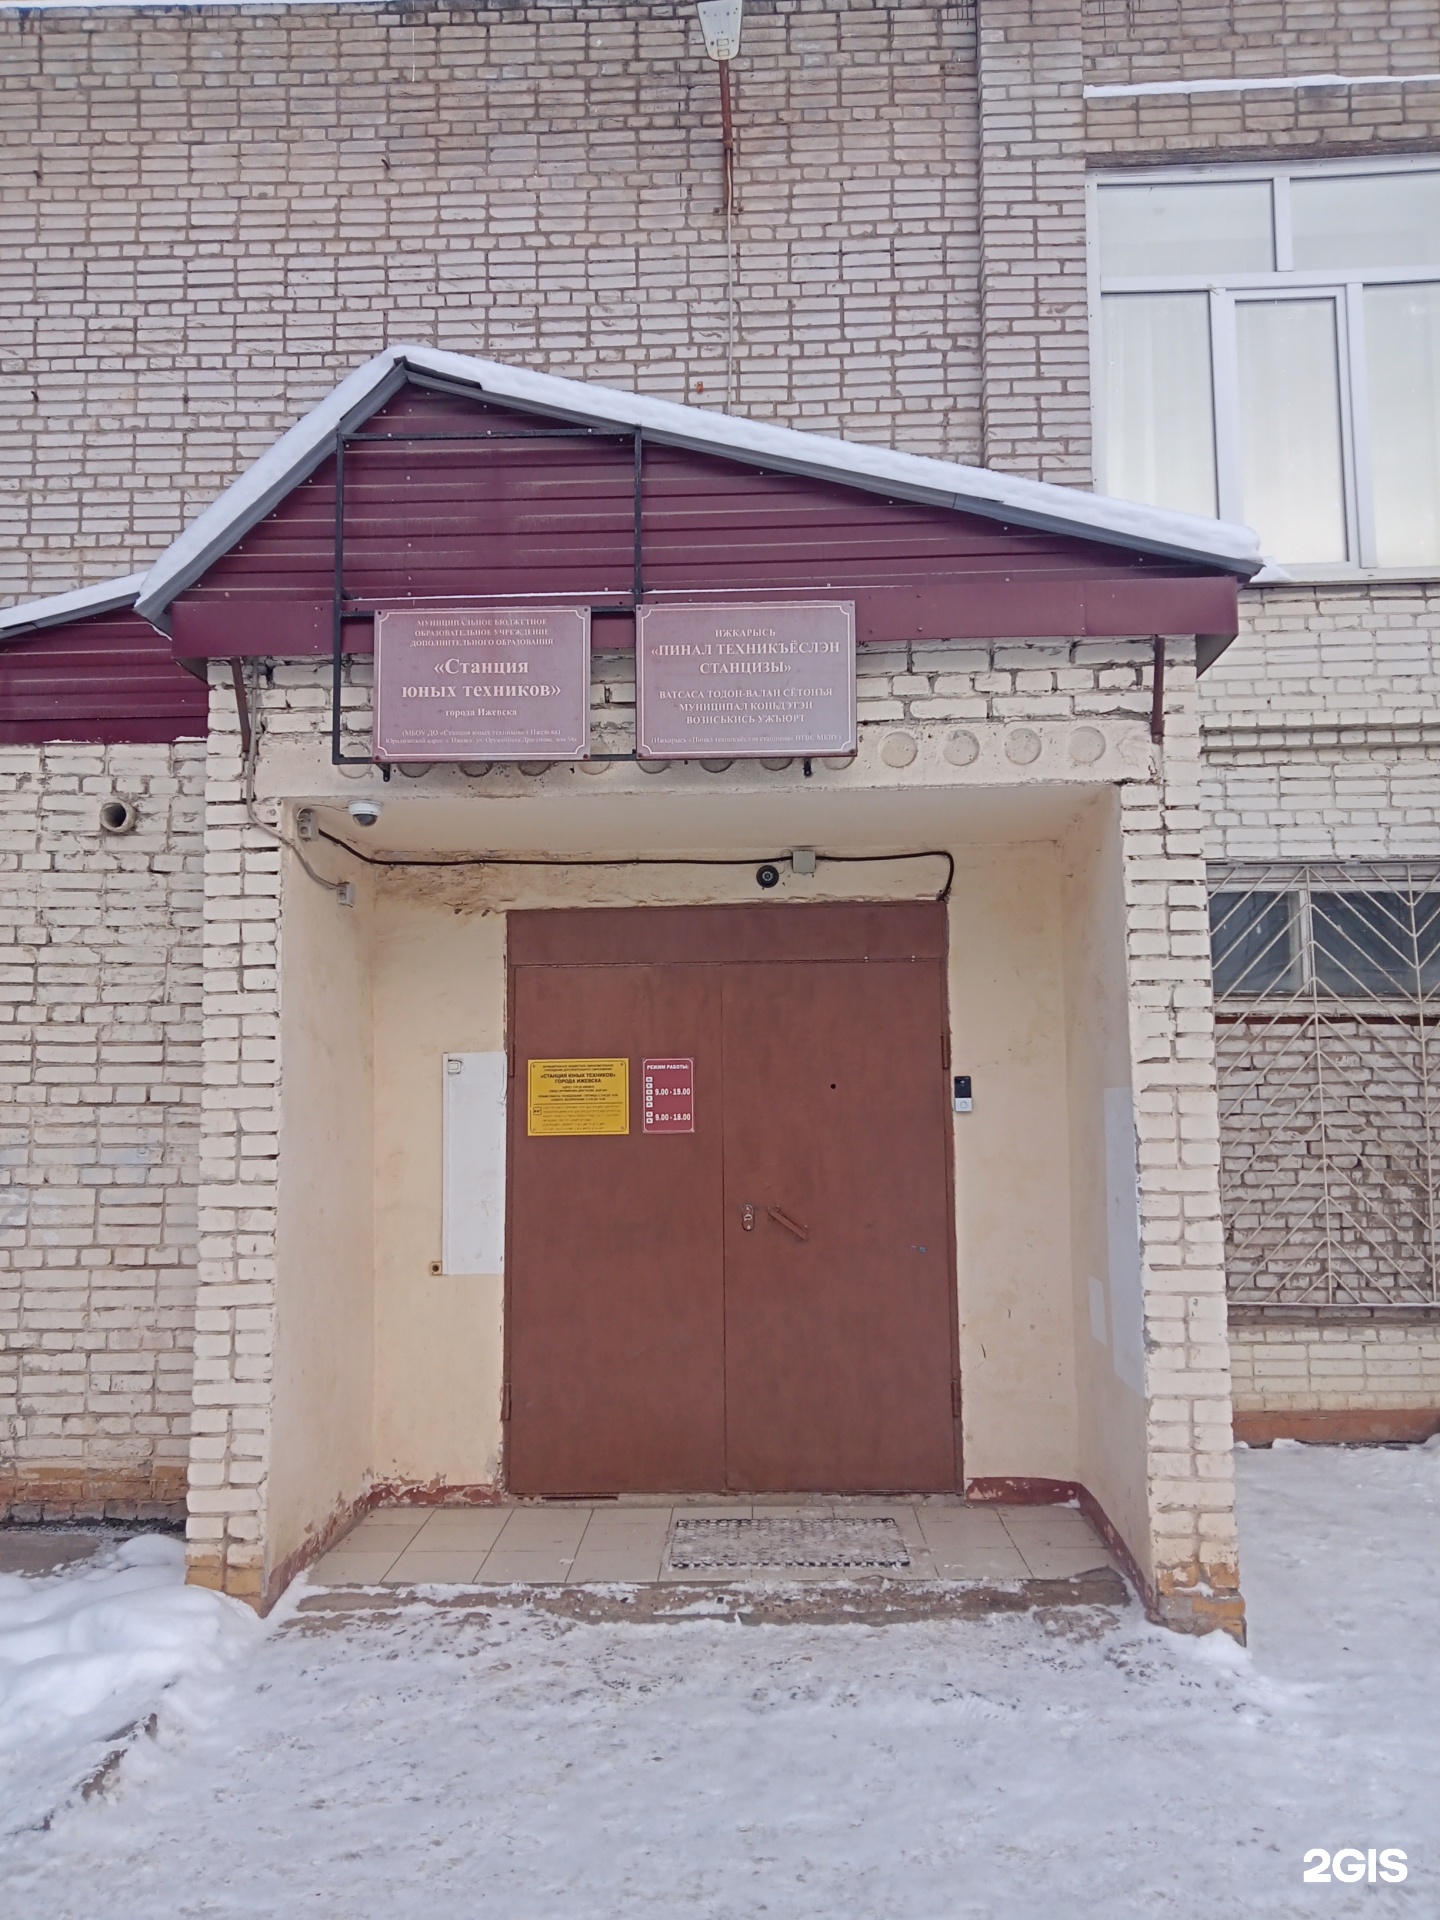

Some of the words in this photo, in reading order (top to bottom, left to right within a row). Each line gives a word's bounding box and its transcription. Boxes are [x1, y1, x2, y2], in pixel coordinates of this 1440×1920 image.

[417, 619, 493, 627] МУНИЦИПАЛЬНОЕ
[494, 618, 548, 626] БЮДЖЕТНОЕ
[414, 629, 492, 637] ОБРАЗОВАТЕЛЬНОЕ
[493, 628, 550, 636] УЧРЕЖДЕНИЕ
[715, 628, 776, 638] ИЖКАРЫСЬ
[410, 638, 495, 647] ДОПОЛНИТЕЛЬНОГО
[495, 638, 554, 646] ОБРАЗОВАНИЯ
[651, 644, 713, 657] «ПИНАЛ
[716, 640, 840, 655] ТЕХНИКЪЁСЛЭН
[433, 658, 529, 675] «Станция
[700, 661, 792, 675] СТАНЦИЗЫ»
[402, 686, 457, 698] юных
[462, 684, 561, 698] техников»
[659, 690, 704, 699] ВАТСАСА
[707, 689, 780, 700] ТОДОН-ВАЛАН
[679, 702, 748, 712] МУНИЦИПАЛ
[445, 708, 475, 718] города
[477, 707, 518, 717] Ижевска
[686, 714, 755, 725] ВОЗИСЬКИСЬ
[654, 1088, 669, 1096] 9.00
[672, 1087, 691, 1096] 19.00
[655, 1113, 669, 1121] 9.00
[673, 1113, 691, 1121] 18.00
